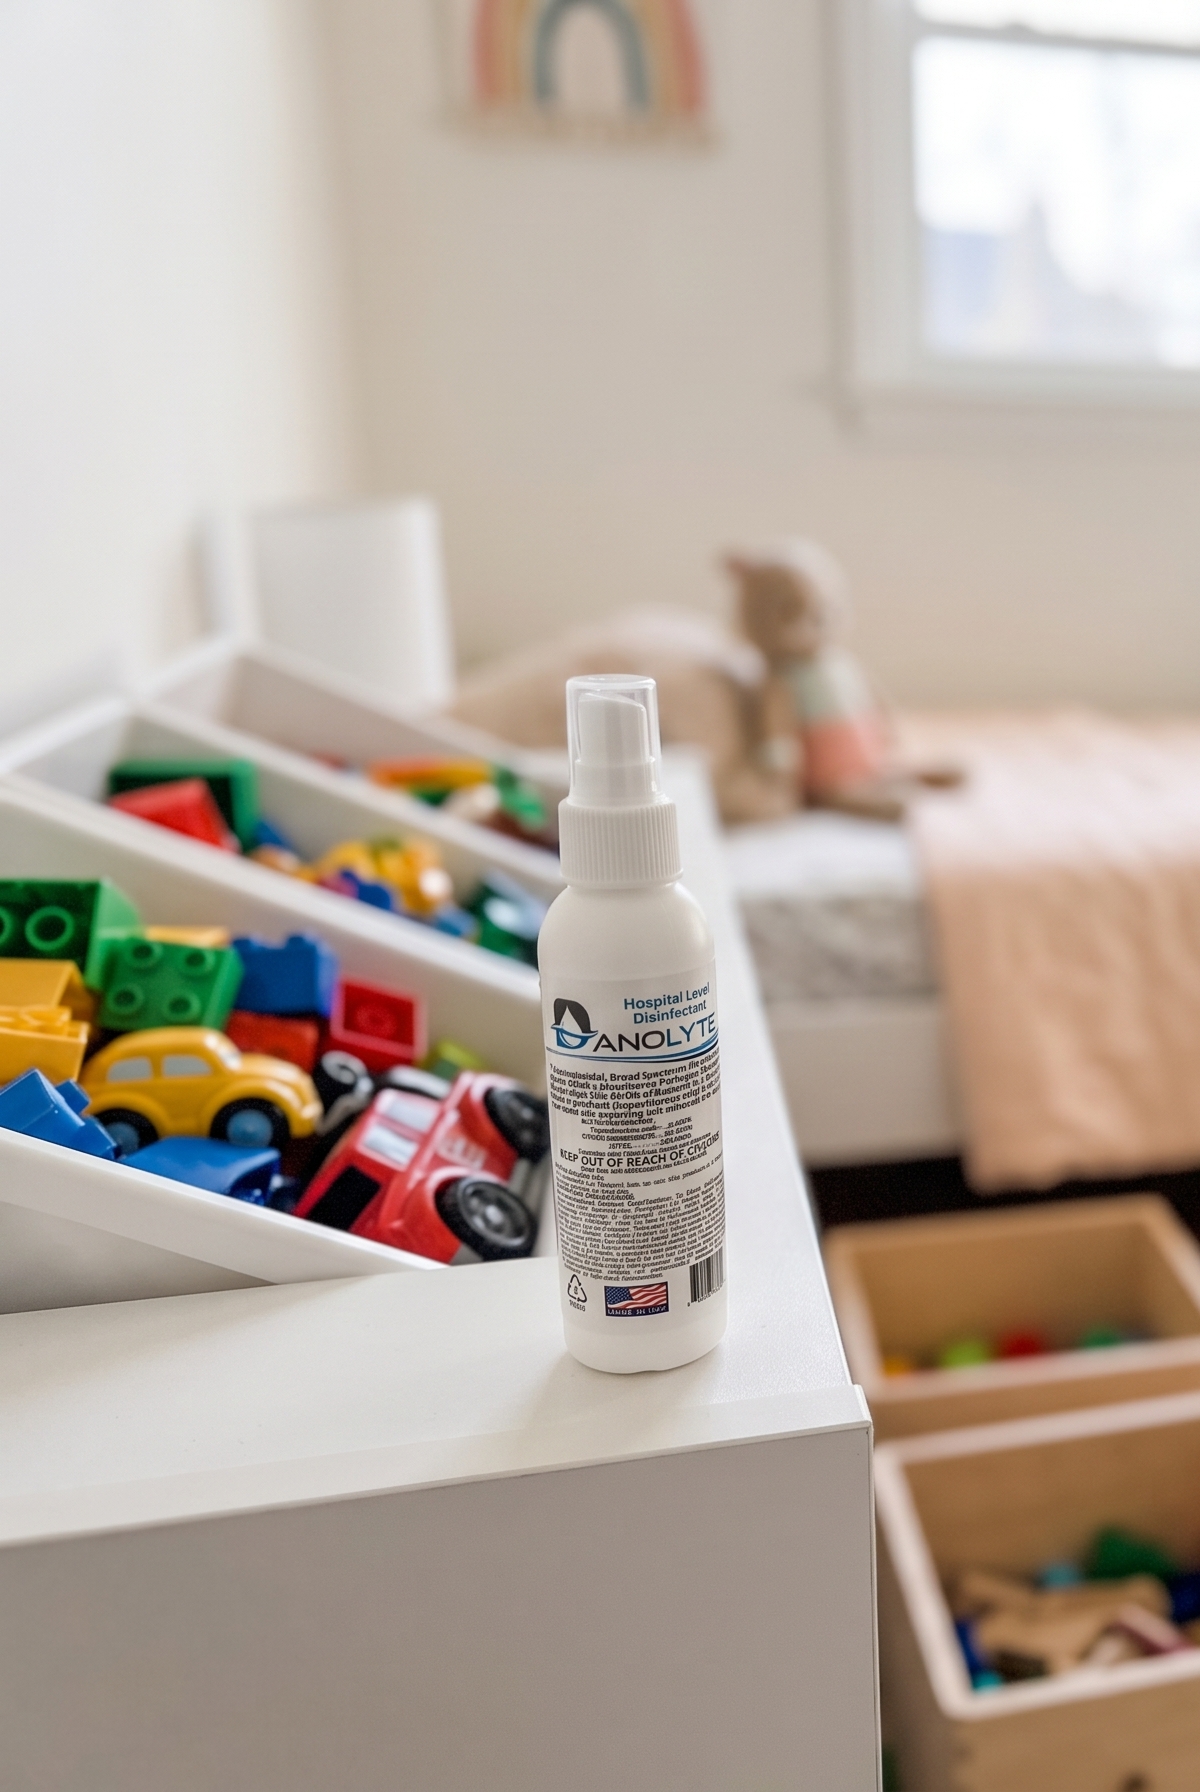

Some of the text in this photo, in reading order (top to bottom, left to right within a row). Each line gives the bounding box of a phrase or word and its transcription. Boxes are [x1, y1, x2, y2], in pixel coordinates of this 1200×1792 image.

[624, 982, 710, 1010] Hospital Level
[634, 1000, 706, 1024] Disinfectant
[593, 1012, 716, 1052] ANOLYTE
[581, 1156, 604, 1167] OUT
[607, 1157, 623, 1167] OF
[627, 1153, 666, 1167] REACH
